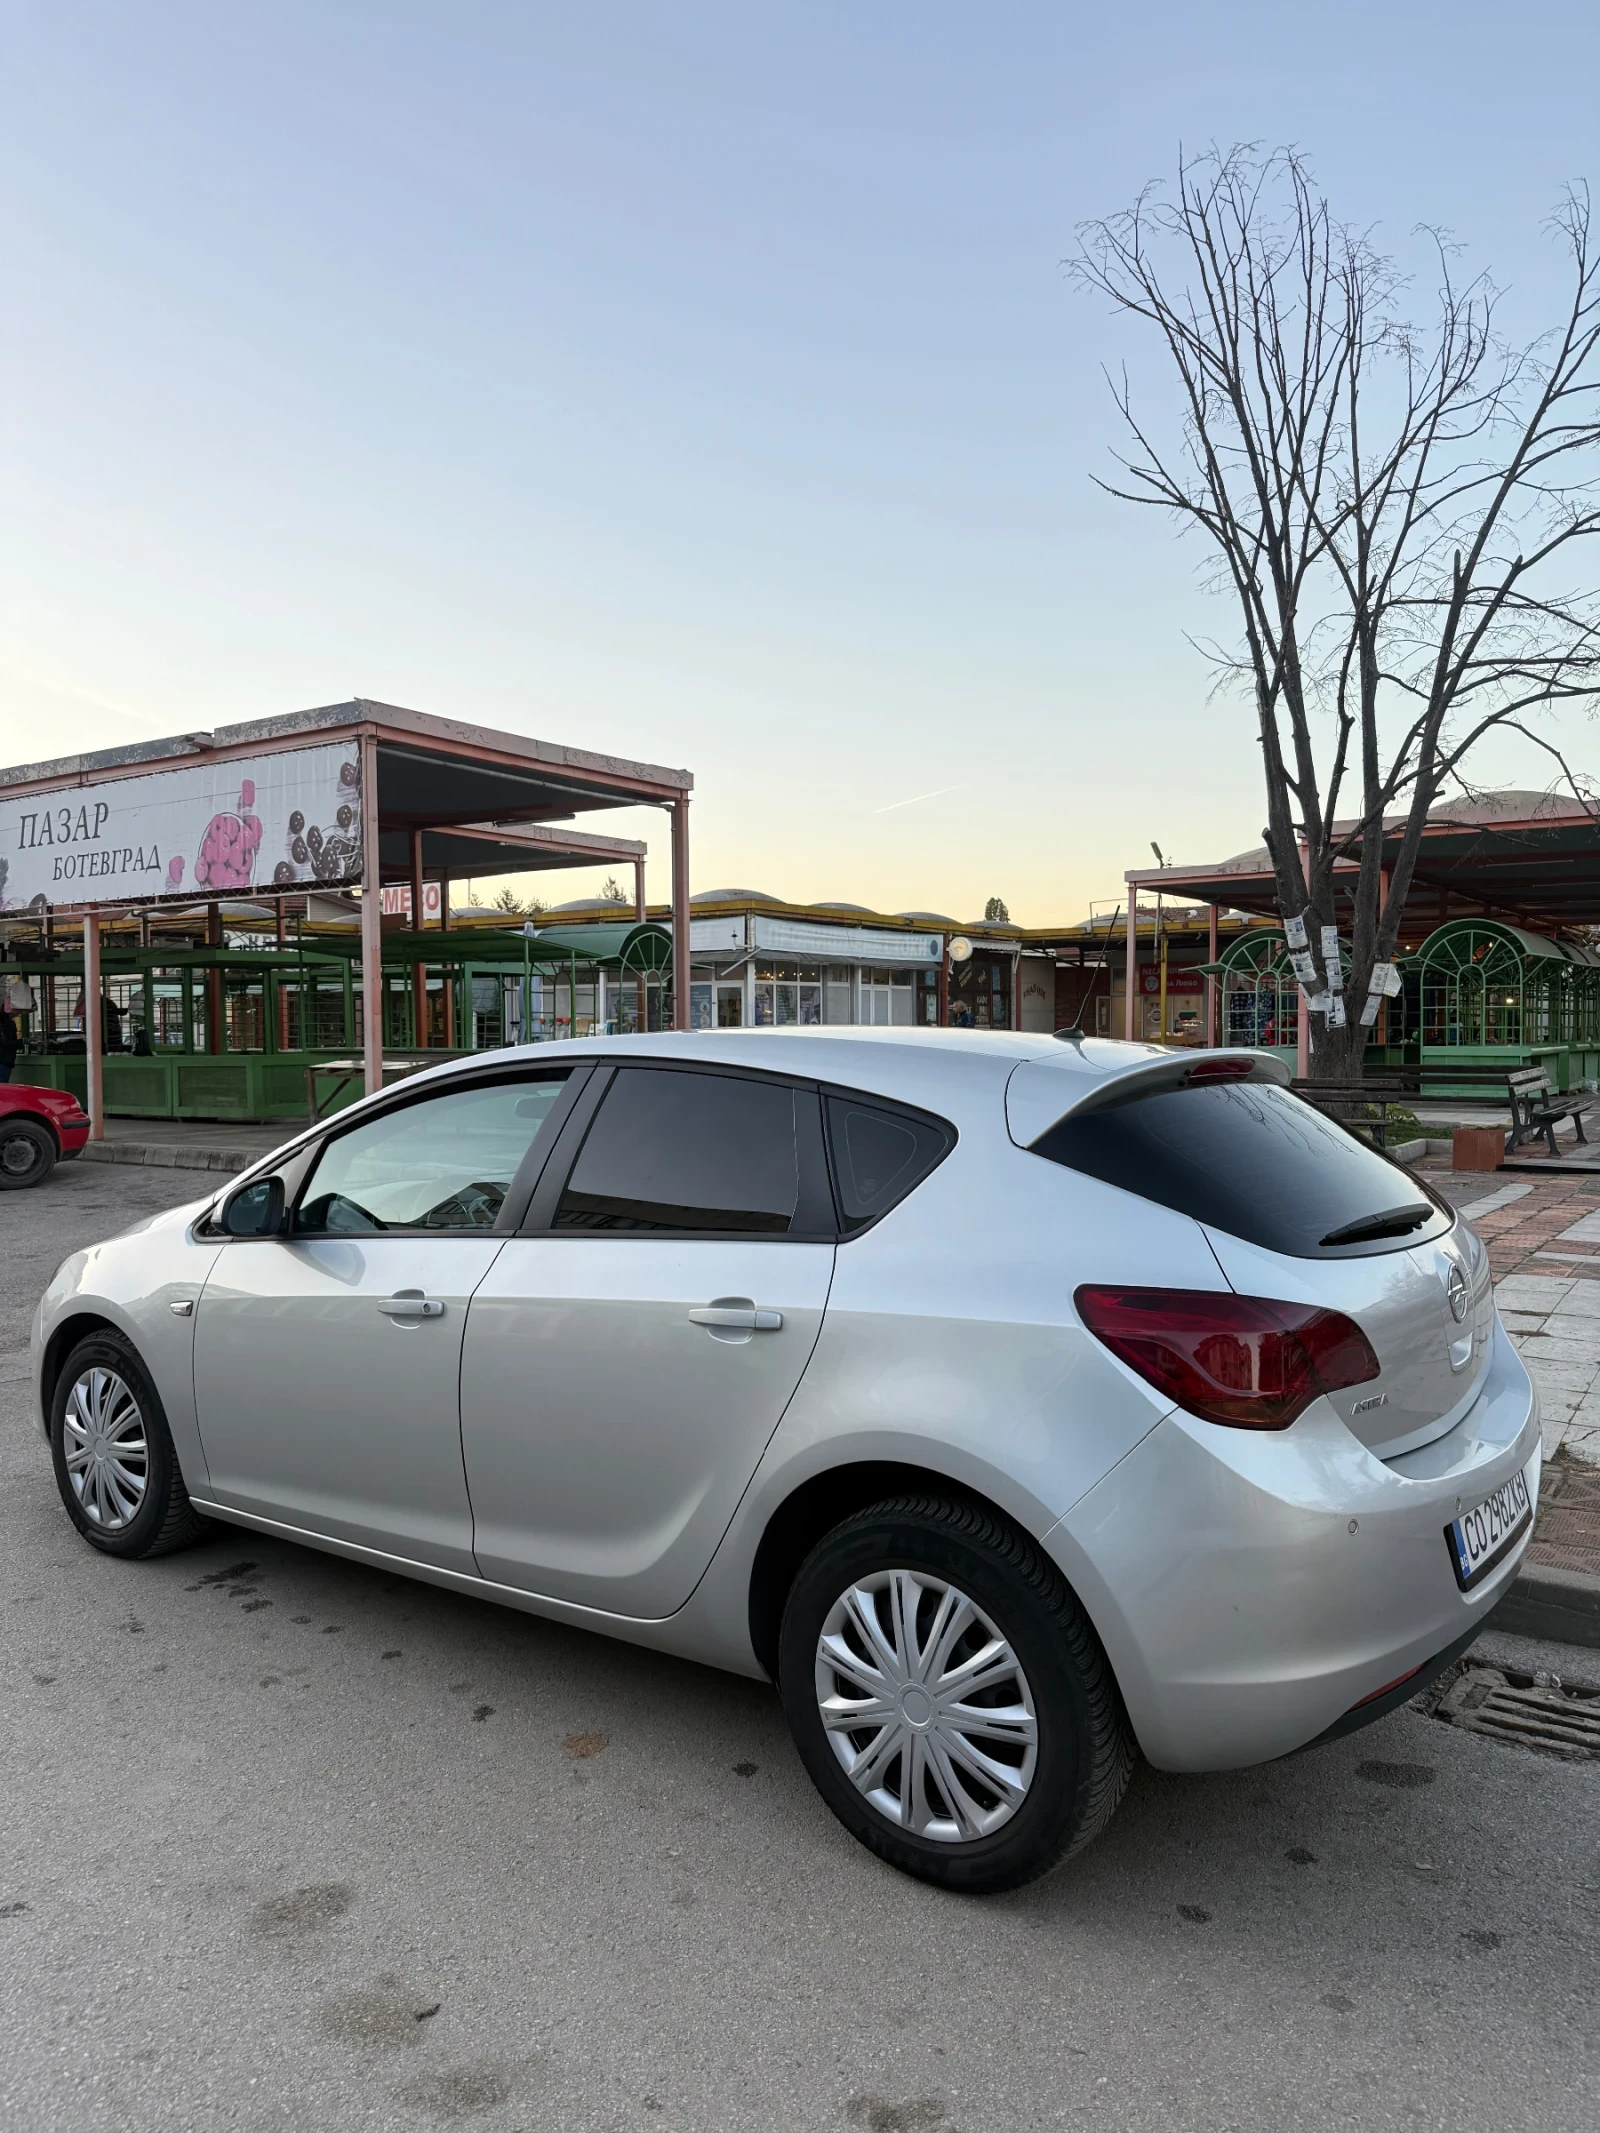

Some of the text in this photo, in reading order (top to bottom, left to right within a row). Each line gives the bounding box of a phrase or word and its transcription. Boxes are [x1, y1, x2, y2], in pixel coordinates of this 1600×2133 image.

[18, 802, 109, 849] ПАЗАР
[52, 845, 161, 880] БОТЕВГРАД
[384, 886, 440, 913] МЕО
